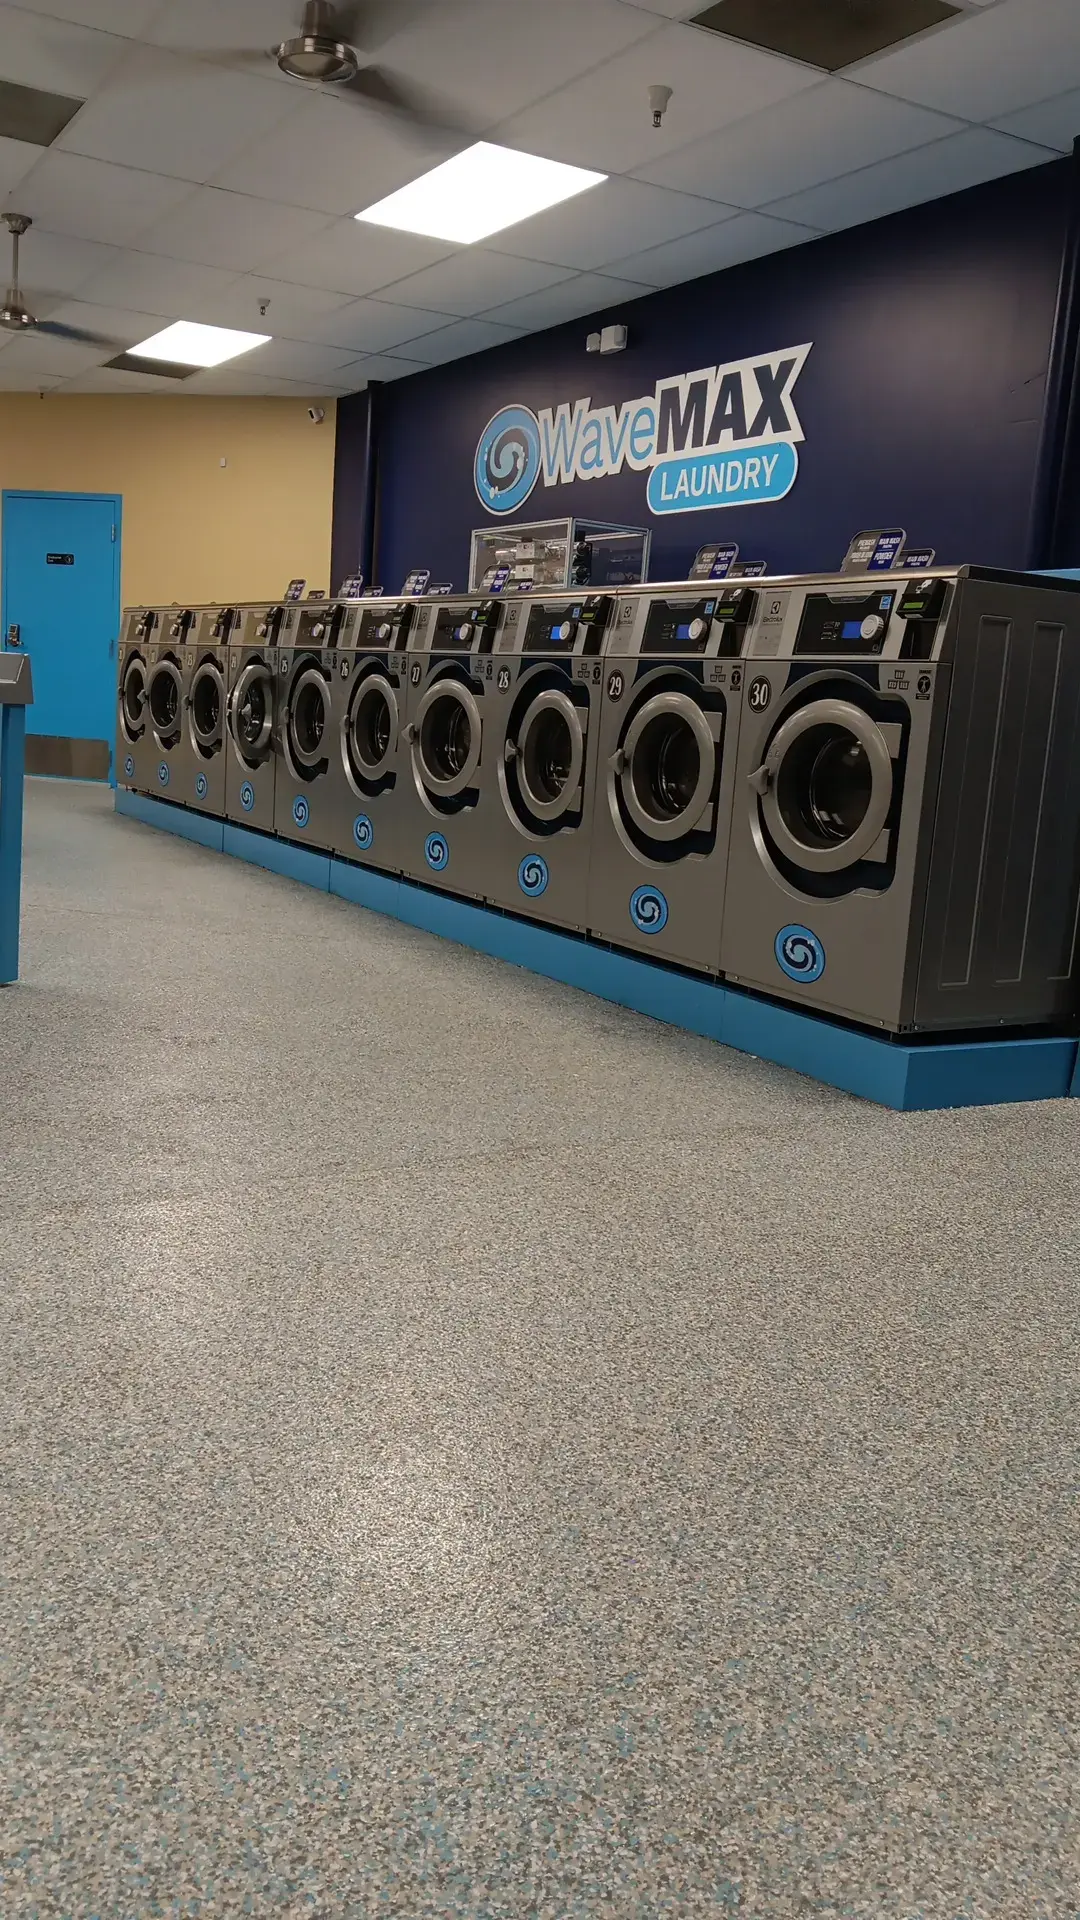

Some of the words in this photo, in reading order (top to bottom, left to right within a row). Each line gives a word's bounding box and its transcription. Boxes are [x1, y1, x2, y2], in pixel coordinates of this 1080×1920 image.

[542, 357, 798, 478] WaveMAX
[660, 453, 779, 500] LAUNDRY
[341, 662, 349, 676] 26
[412, 667, 421, 682] 27
[499, 671, 509, 689] 28
[609, 676, 622, 696] 29
[751, 682, 769, 706] 30
